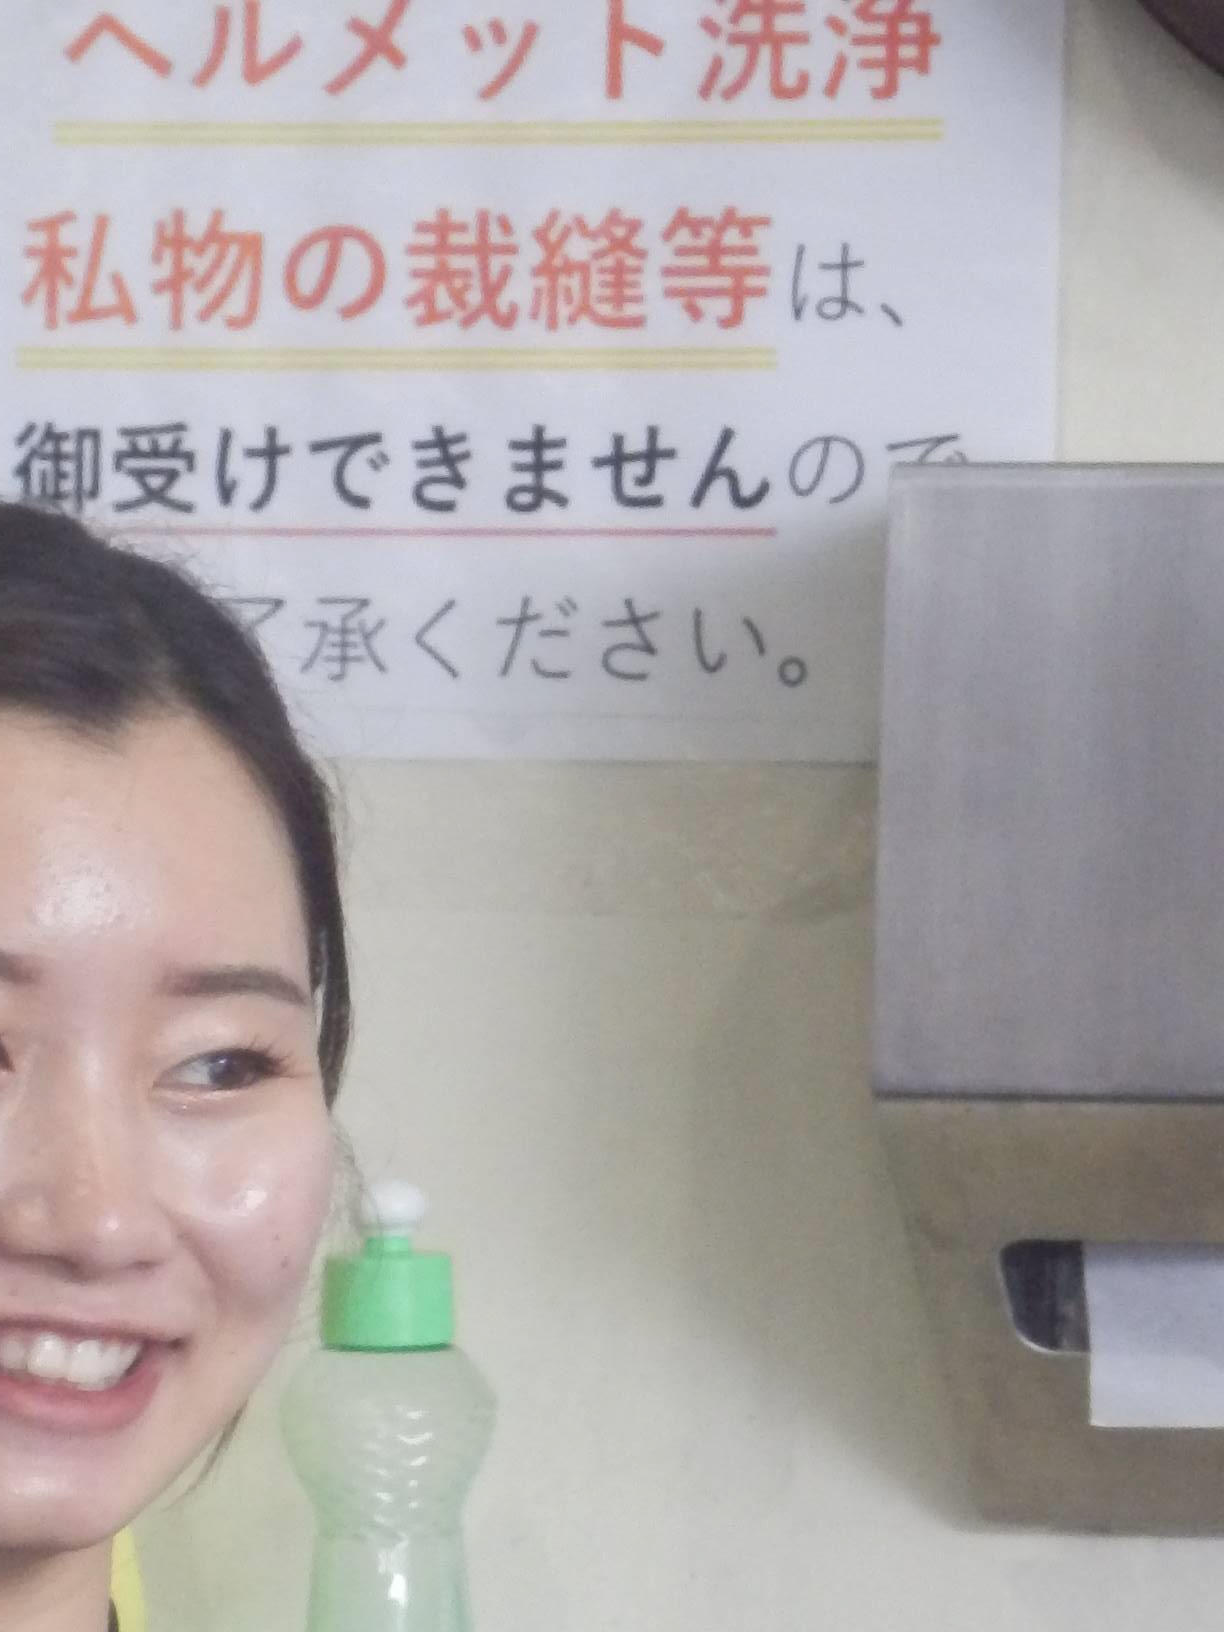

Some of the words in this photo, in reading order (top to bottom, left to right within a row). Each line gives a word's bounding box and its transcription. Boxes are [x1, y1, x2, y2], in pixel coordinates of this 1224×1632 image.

[64, 0, 942, 102] ヘルメット洗浄
[22, 206, 904, 333] 私物の裁縫等は、
